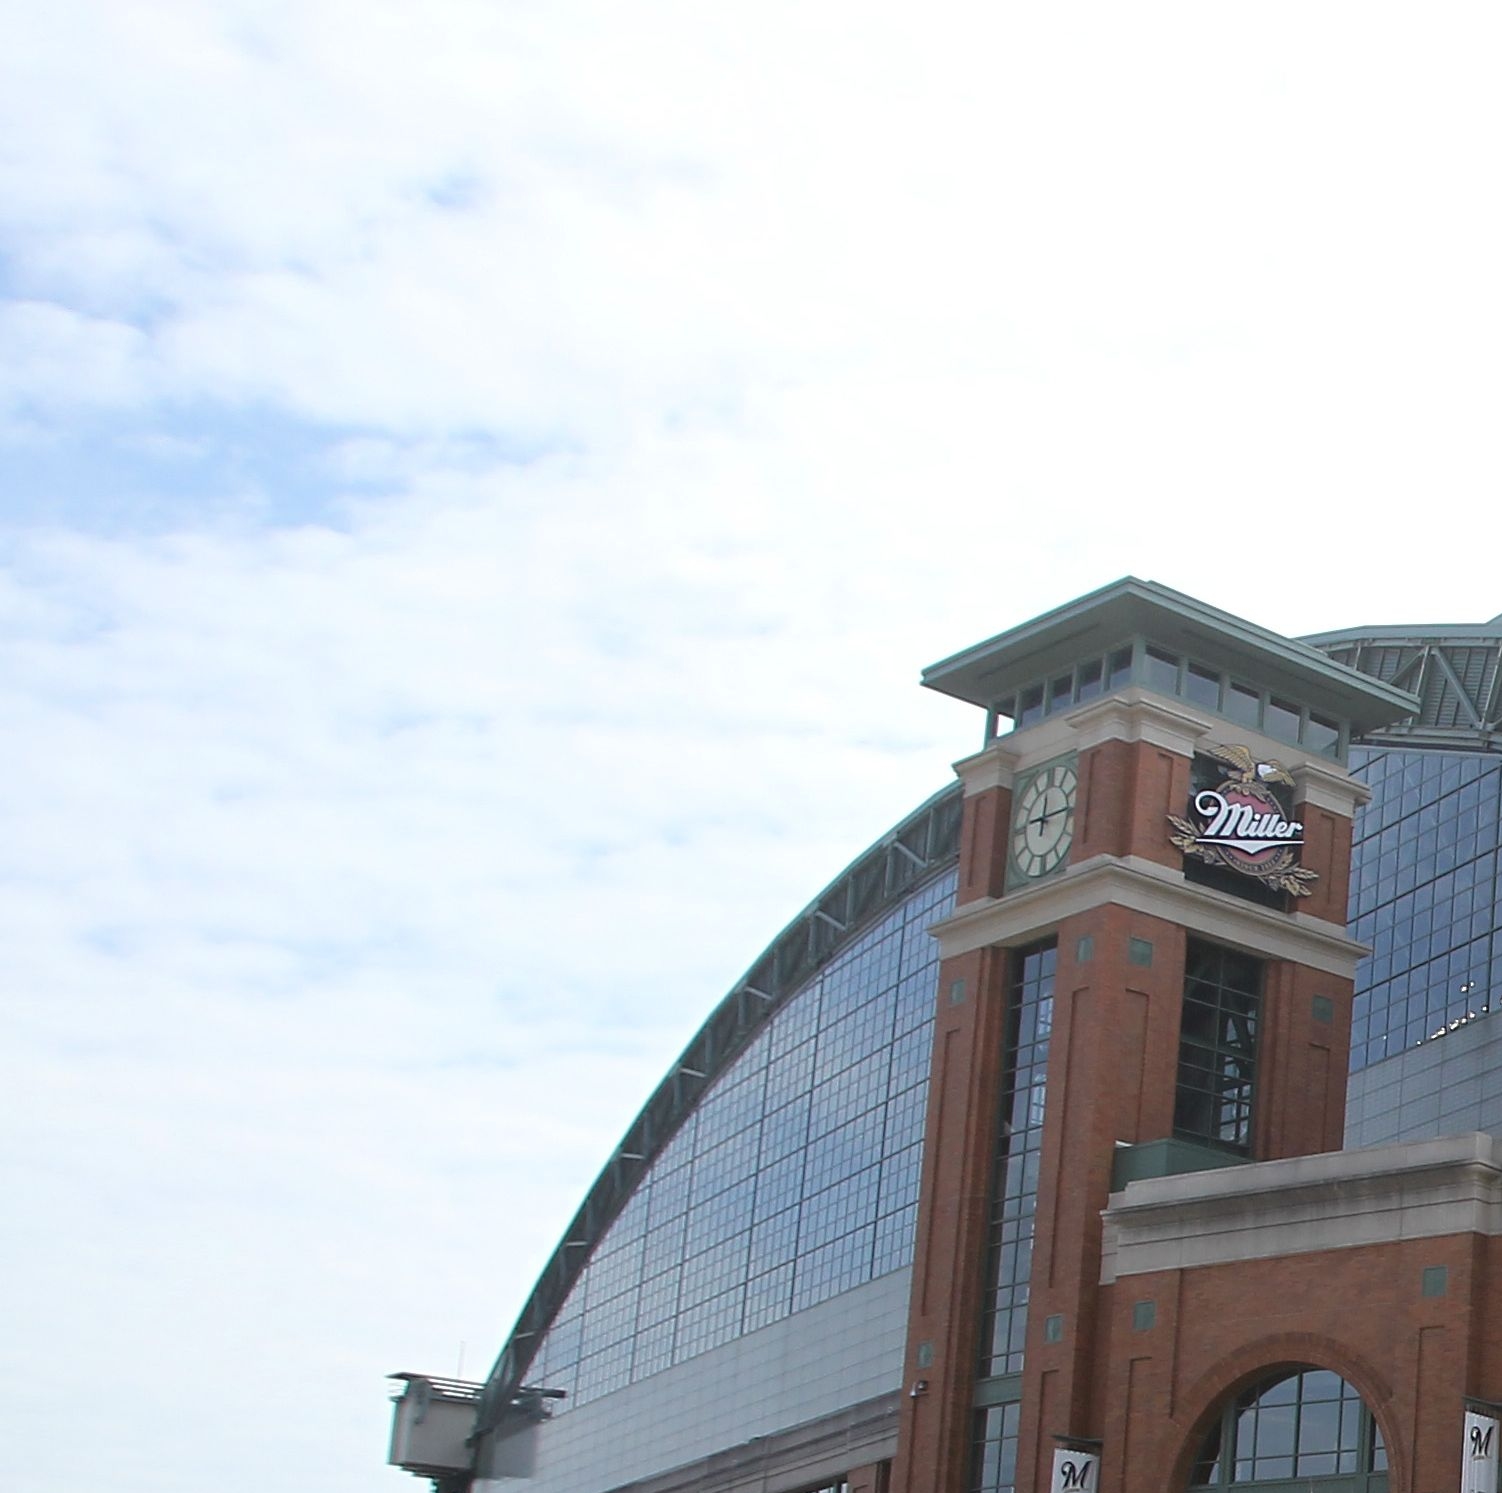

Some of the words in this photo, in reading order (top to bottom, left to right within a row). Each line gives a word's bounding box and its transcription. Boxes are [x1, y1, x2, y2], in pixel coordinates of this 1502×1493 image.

[1195, 790, 1303, 838] Miller
[1470, 1424, 1493, 1456] M
[1061, 1460, 1093, 1490] M
